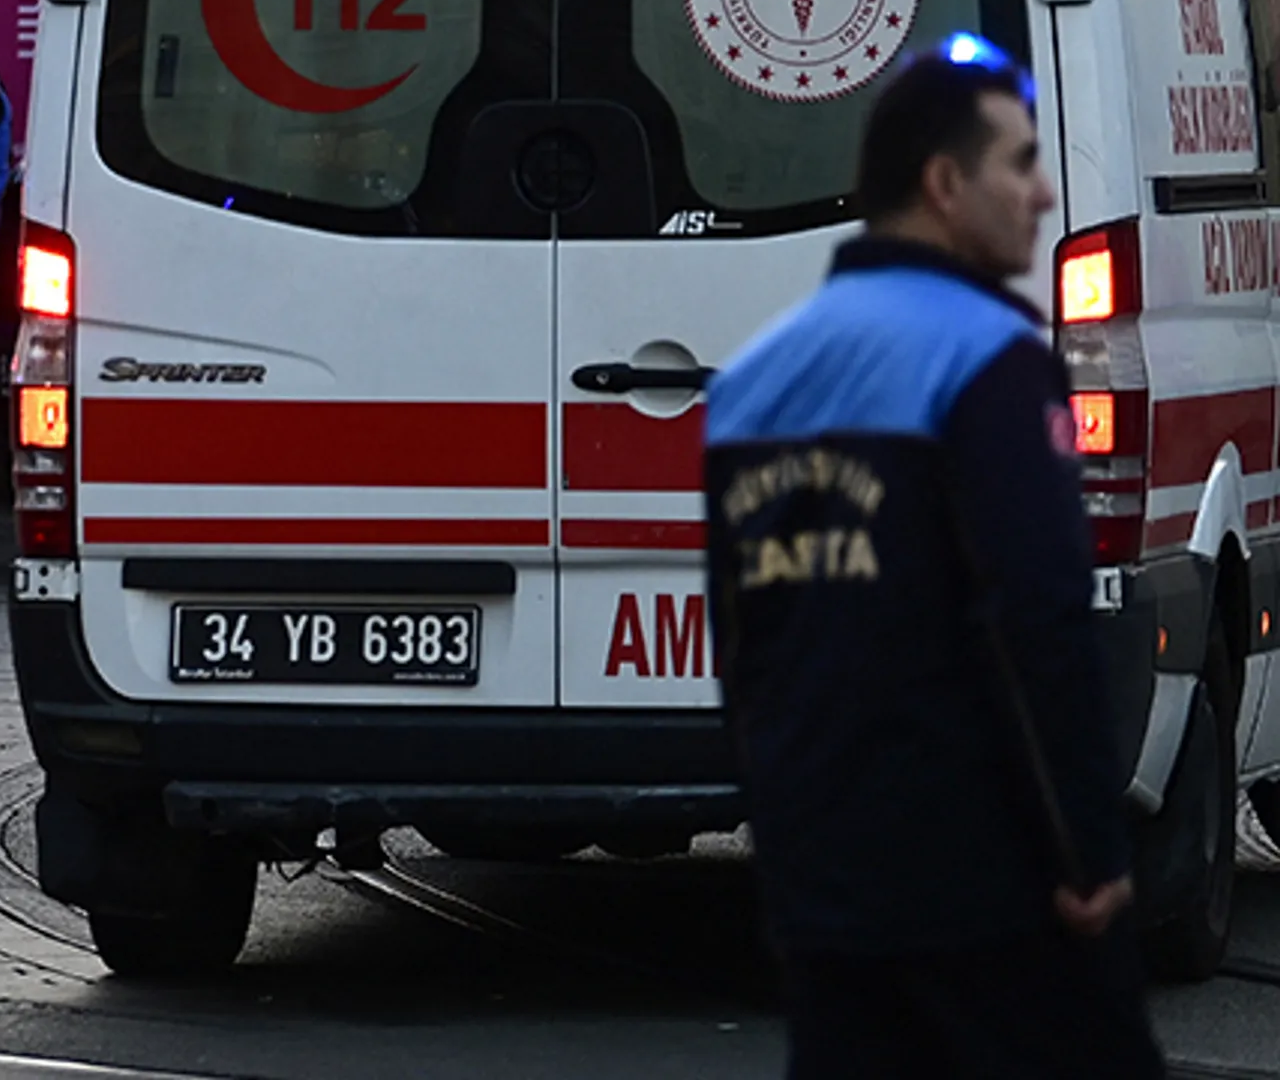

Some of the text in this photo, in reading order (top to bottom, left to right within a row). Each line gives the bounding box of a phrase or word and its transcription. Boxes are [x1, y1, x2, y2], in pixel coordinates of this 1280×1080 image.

[202, 615, 470, 665] 34 YB 6383
